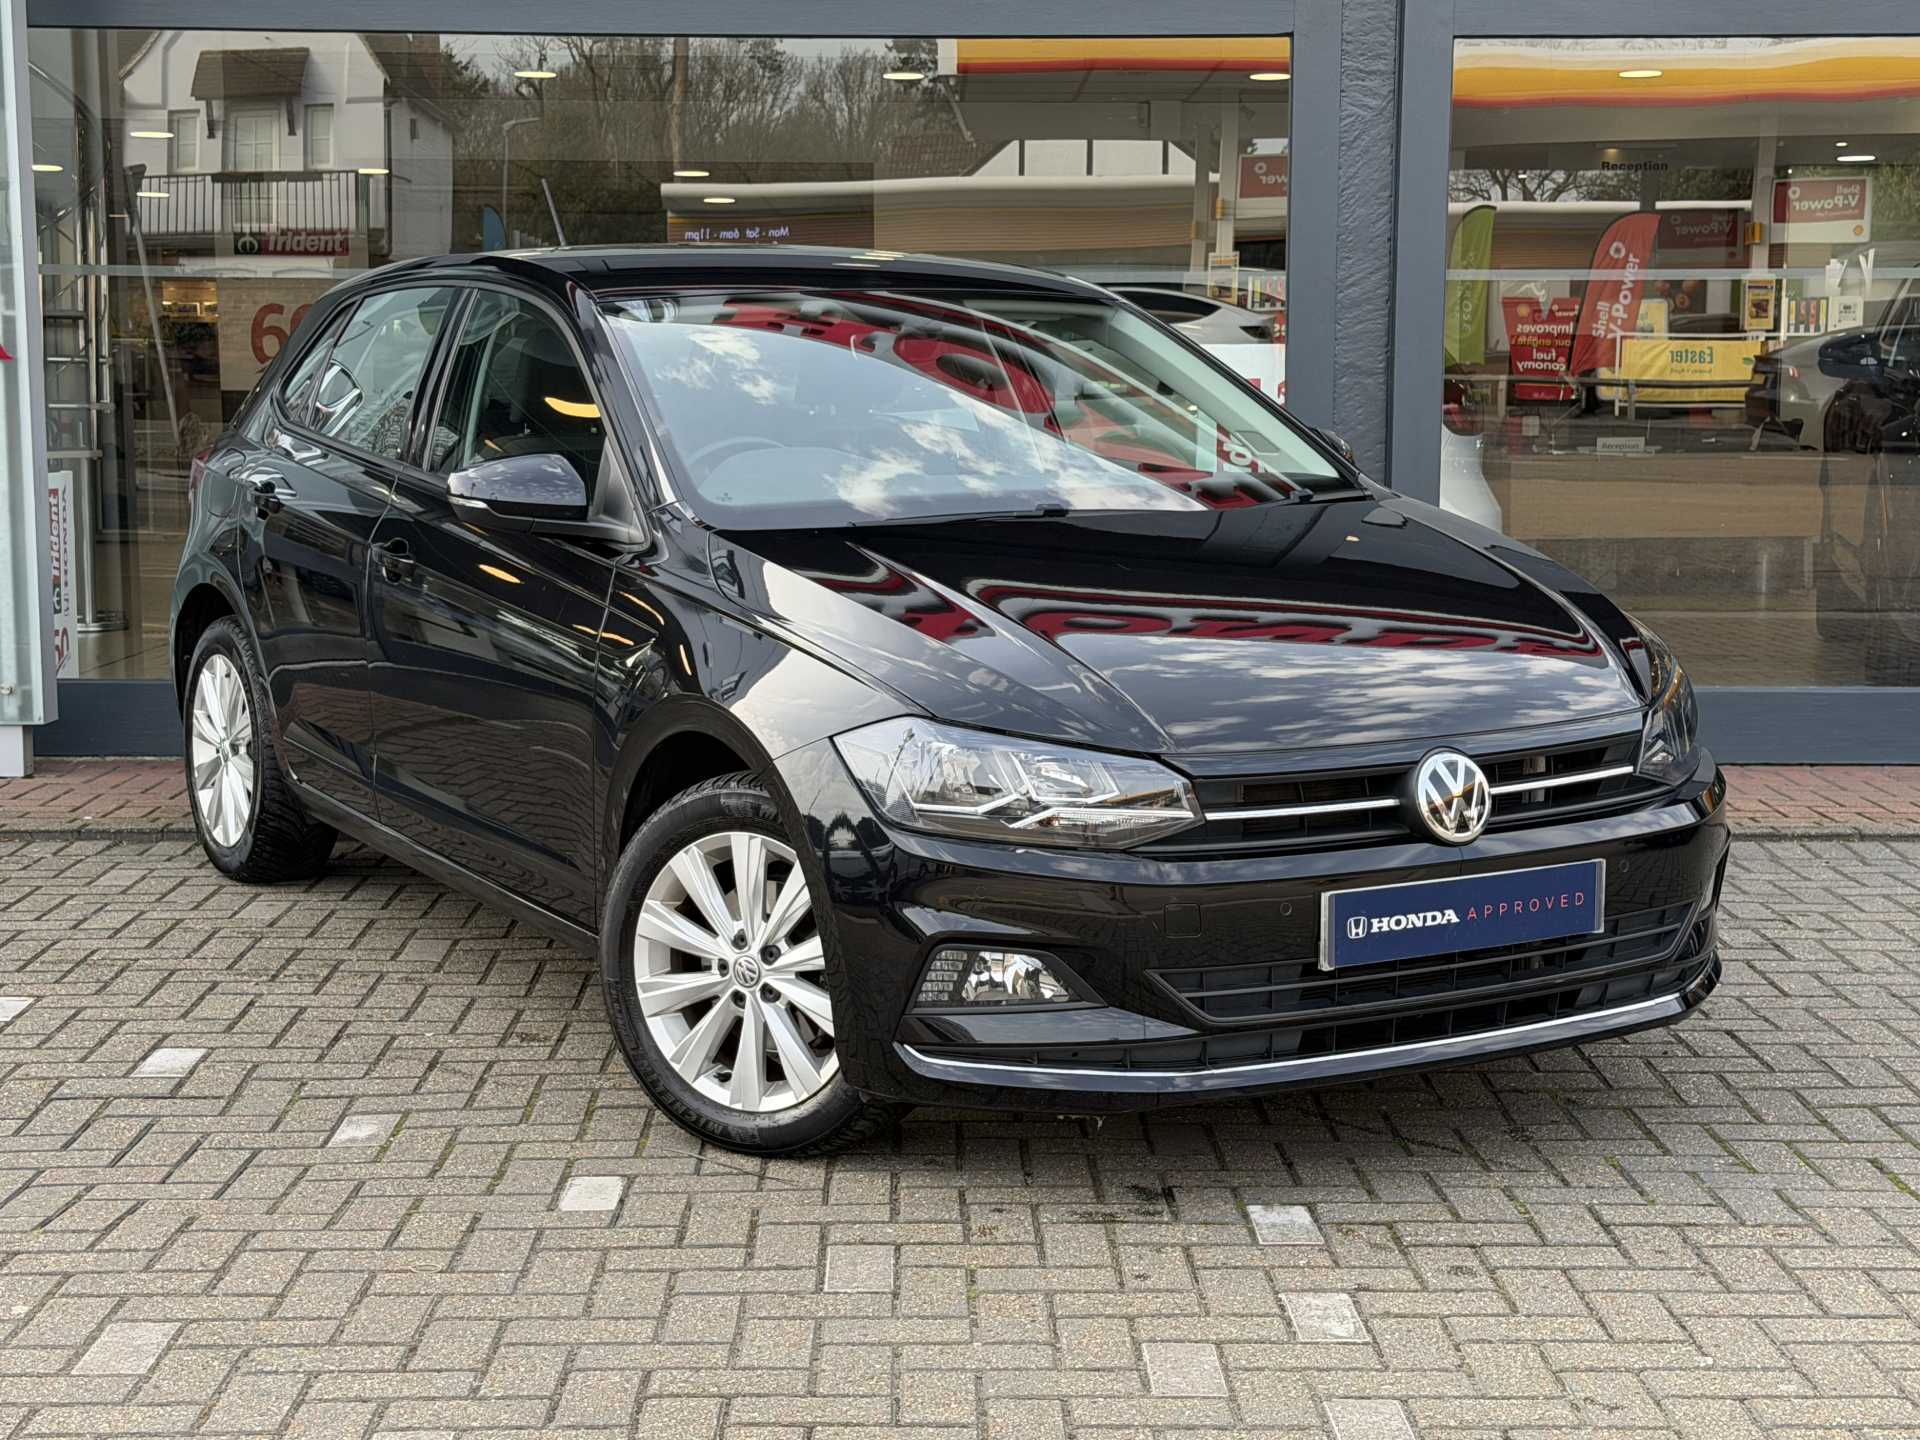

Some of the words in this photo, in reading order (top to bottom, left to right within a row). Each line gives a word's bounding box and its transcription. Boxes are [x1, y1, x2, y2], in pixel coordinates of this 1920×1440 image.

[1601, 161, 1669, 172] Reception
[267, 231, 344, 252] Trident
[1607, 253, 1640, 340] V-Power
[1593, 301, 1611, 338] Shell
[1370, 909, 1460, 933] HONDA
[1467, 891, 1585, 921] APPROVED
